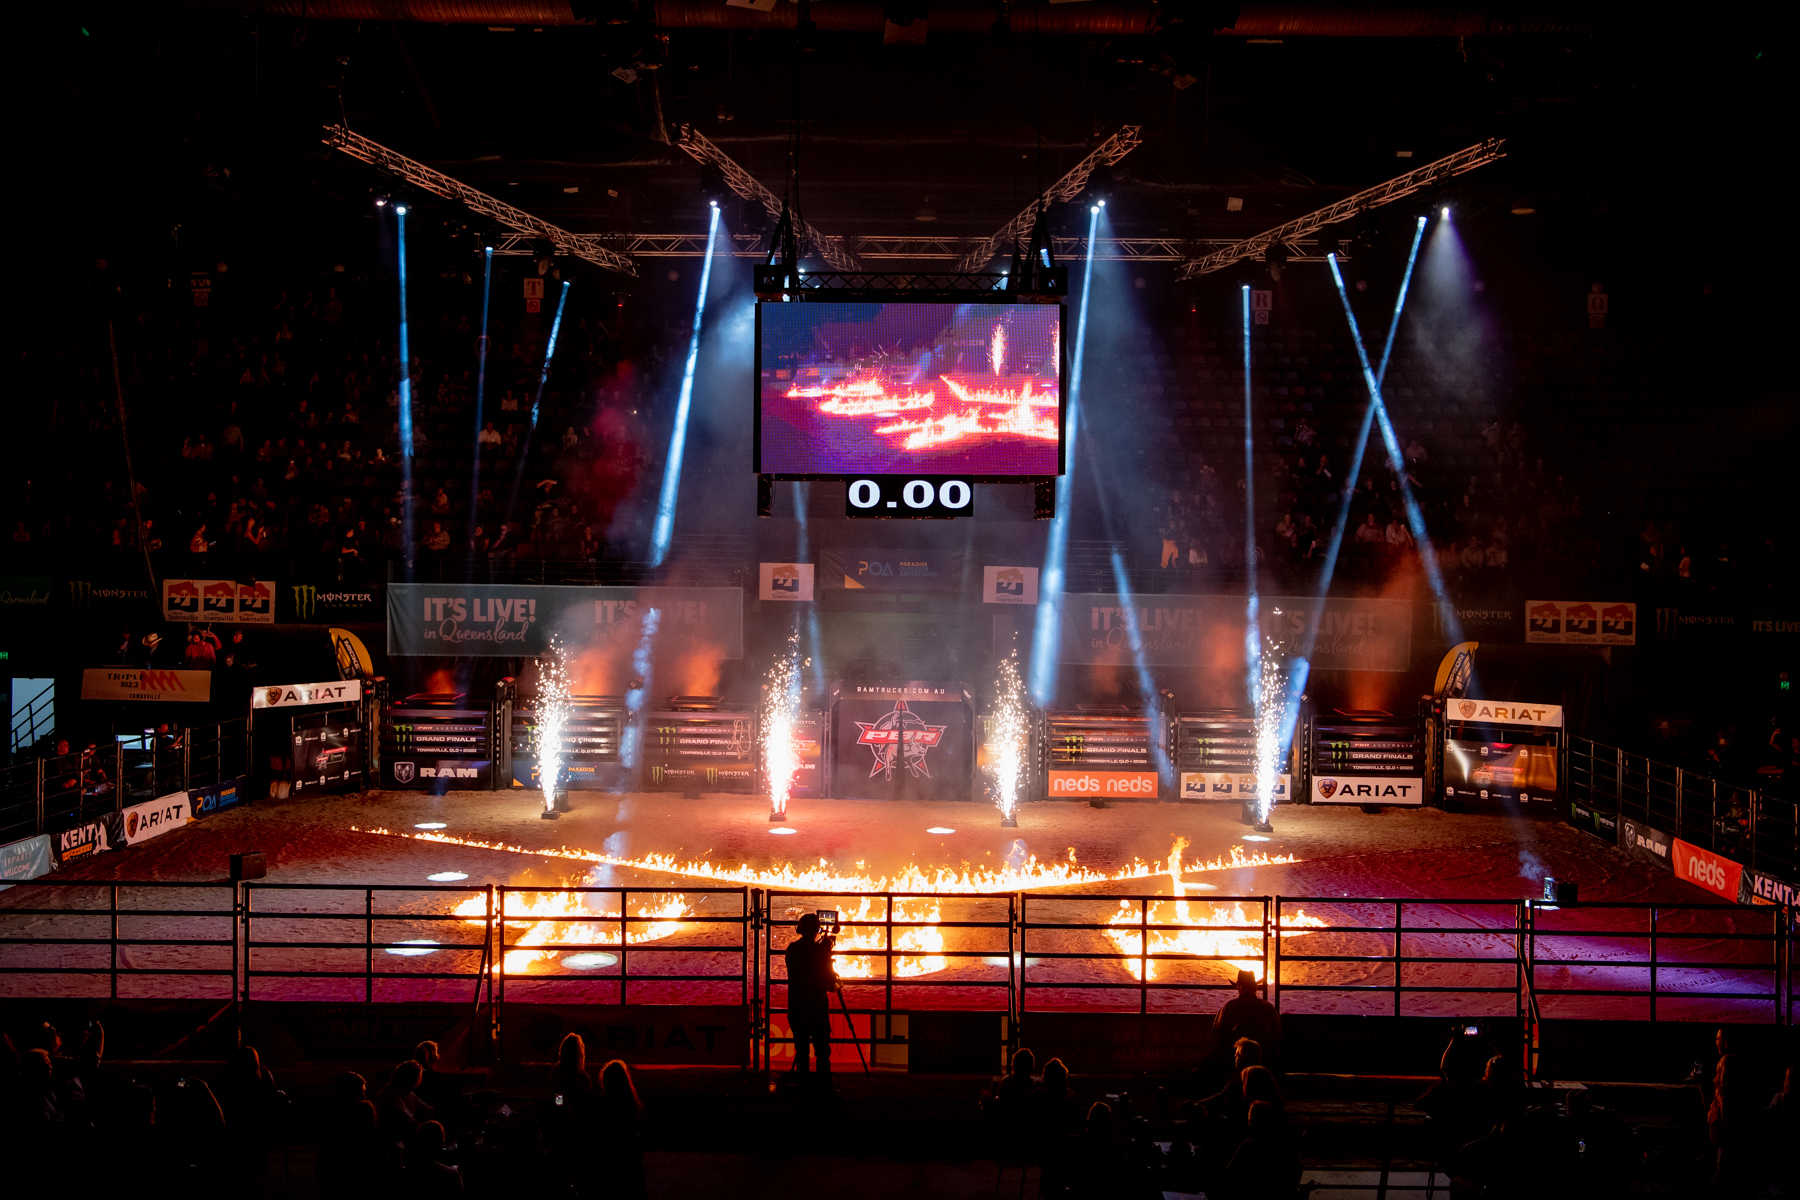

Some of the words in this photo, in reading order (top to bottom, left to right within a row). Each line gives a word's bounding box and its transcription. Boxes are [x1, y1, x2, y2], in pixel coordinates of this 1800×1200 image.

[849, 480, 972, 508] 0.00
[316, 592, 372, 602] MONSTER
[423, 597, 467, 622] IT'S
[473, 598, 536, 623] LIVE!
[424, 628, 436, 640] in
[439, 617, 528, 643] Queensland
[1479, 706, 1546, 721] ARIAT
[864, 731, 937, 742] PBR
[420, 767, 479, 778] RAM
[1053, 775, 1101, 792] neds
[1106, 776, 1152, 792] neds
[1339, 784, 1412, 798] ARIAT
[140, 805, 183, 831] ARIAT
[1636, 833, 1667, 858] RAM
[1688, 855, 1726, 891] neds
